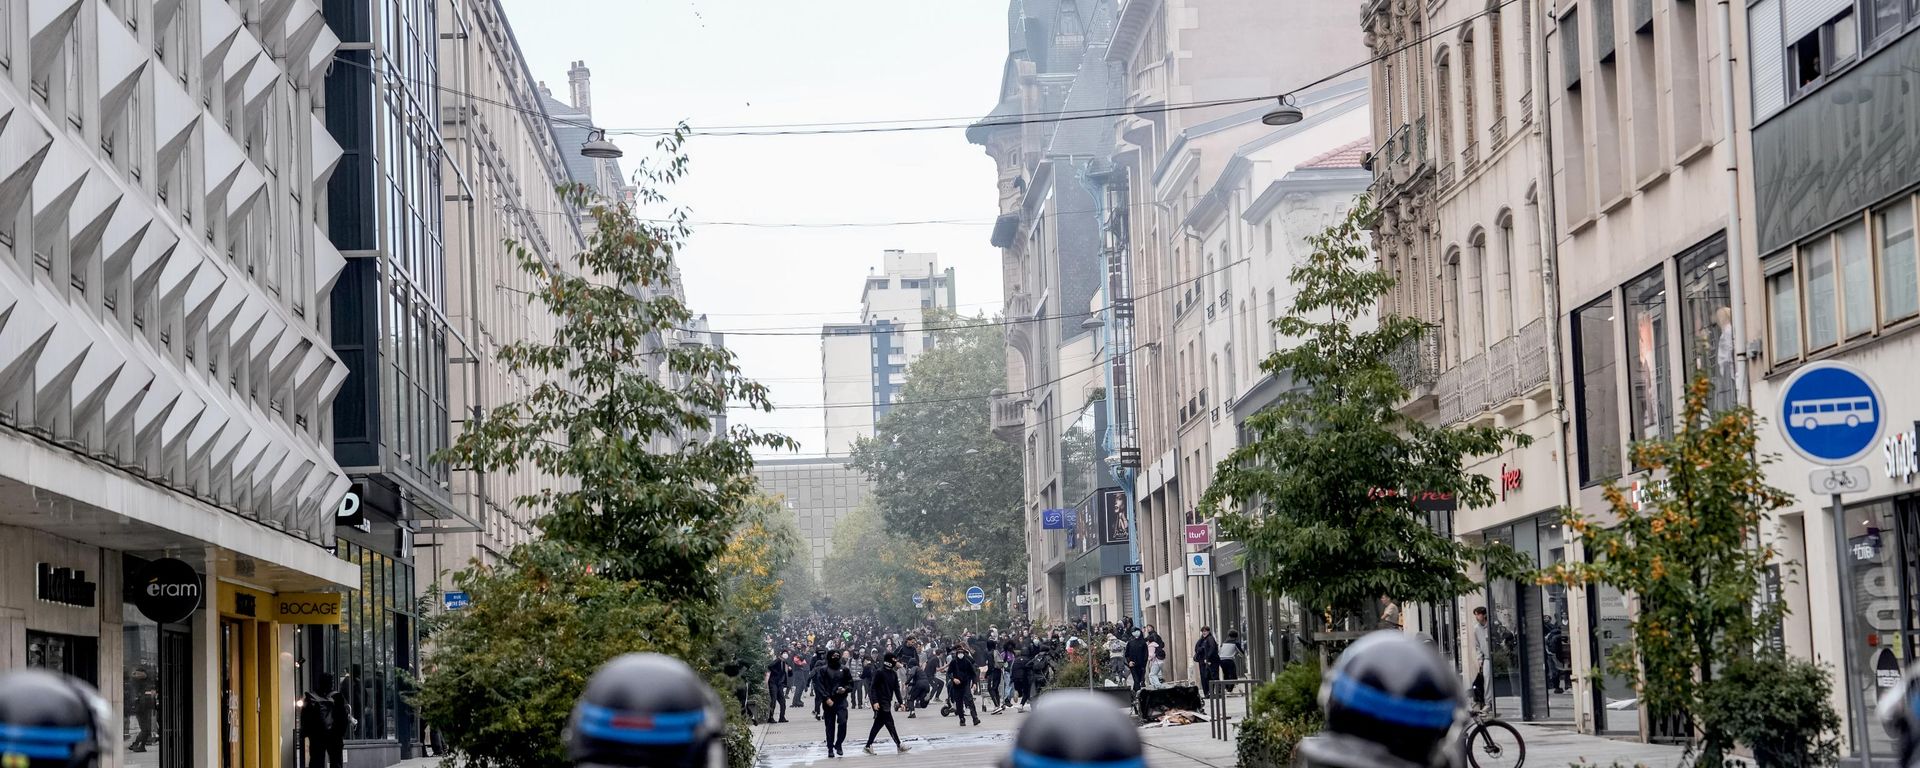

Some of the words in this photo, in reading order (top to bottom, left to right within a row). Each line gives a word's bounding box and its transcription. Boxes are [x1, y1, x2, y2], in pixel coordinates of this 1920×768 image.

[1500, 463, 1521, 502] free
[147, 577, 197, 597] éram
[280, 602, 338, 615] BOCAGE
